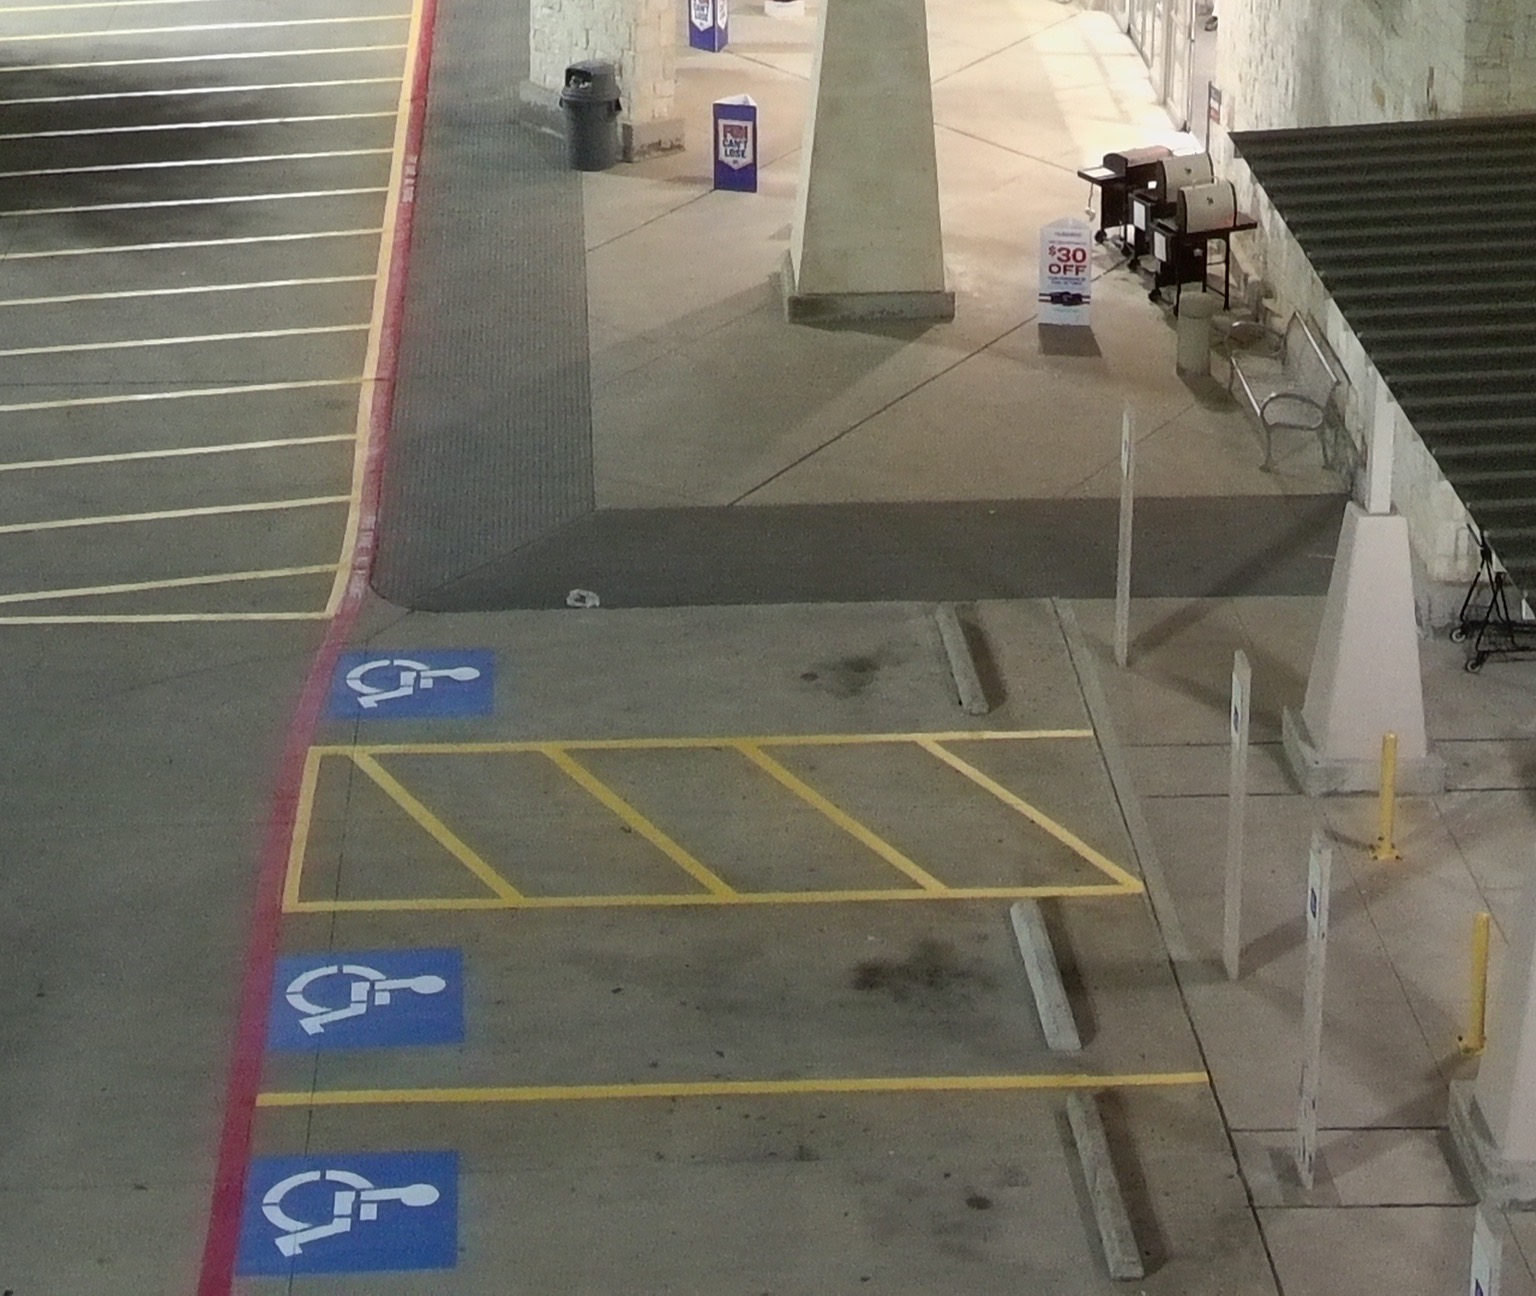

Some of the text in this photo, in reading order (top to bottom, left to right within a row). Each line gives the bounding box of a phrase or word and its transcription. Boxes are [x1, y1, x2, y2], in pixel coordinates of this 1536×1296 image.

[724, 148, 746, 158] LOSE
[1048, 245, 1086, 263] $30
[1048, 263, 1087, 275] OFF
